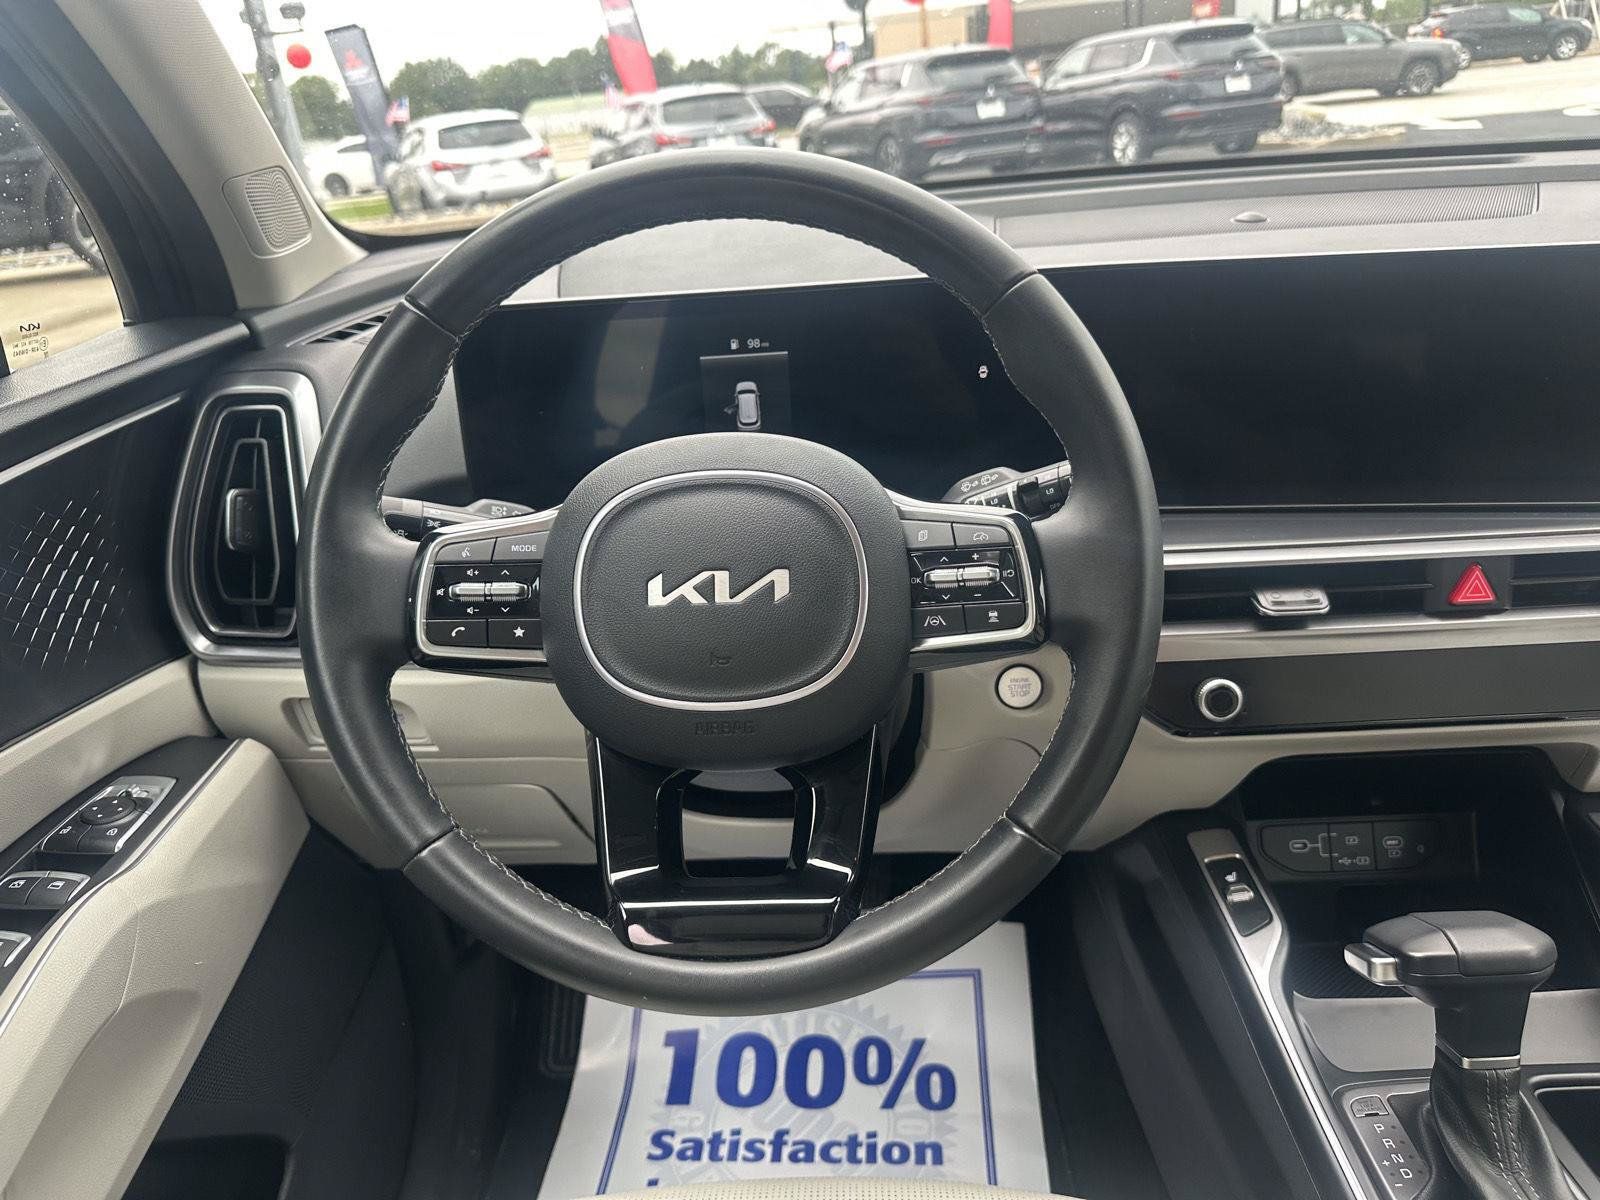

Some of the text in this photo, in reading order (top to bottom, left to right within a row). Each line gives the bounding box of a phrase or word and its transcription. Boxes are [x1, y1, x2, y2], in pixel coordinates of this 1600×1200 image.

[747, 338, 760, 349] 98
[511, 544, 537, 552] MODE
[647, 568, 790, 606] KIA
[1008, 683, 1032, 691] START
[1010, 690, 1031, 698] STOP
[664, 1028, 957, 1111] 100%
[1373, 1123, 1385, 1134] P
[645, 1127, 944, 1166] Satisfaction
[1382, 1138, 1396, 1149] R
[1390, 1153, 1404, 1164] N
[1399, 1168, 1413, 1179] D
